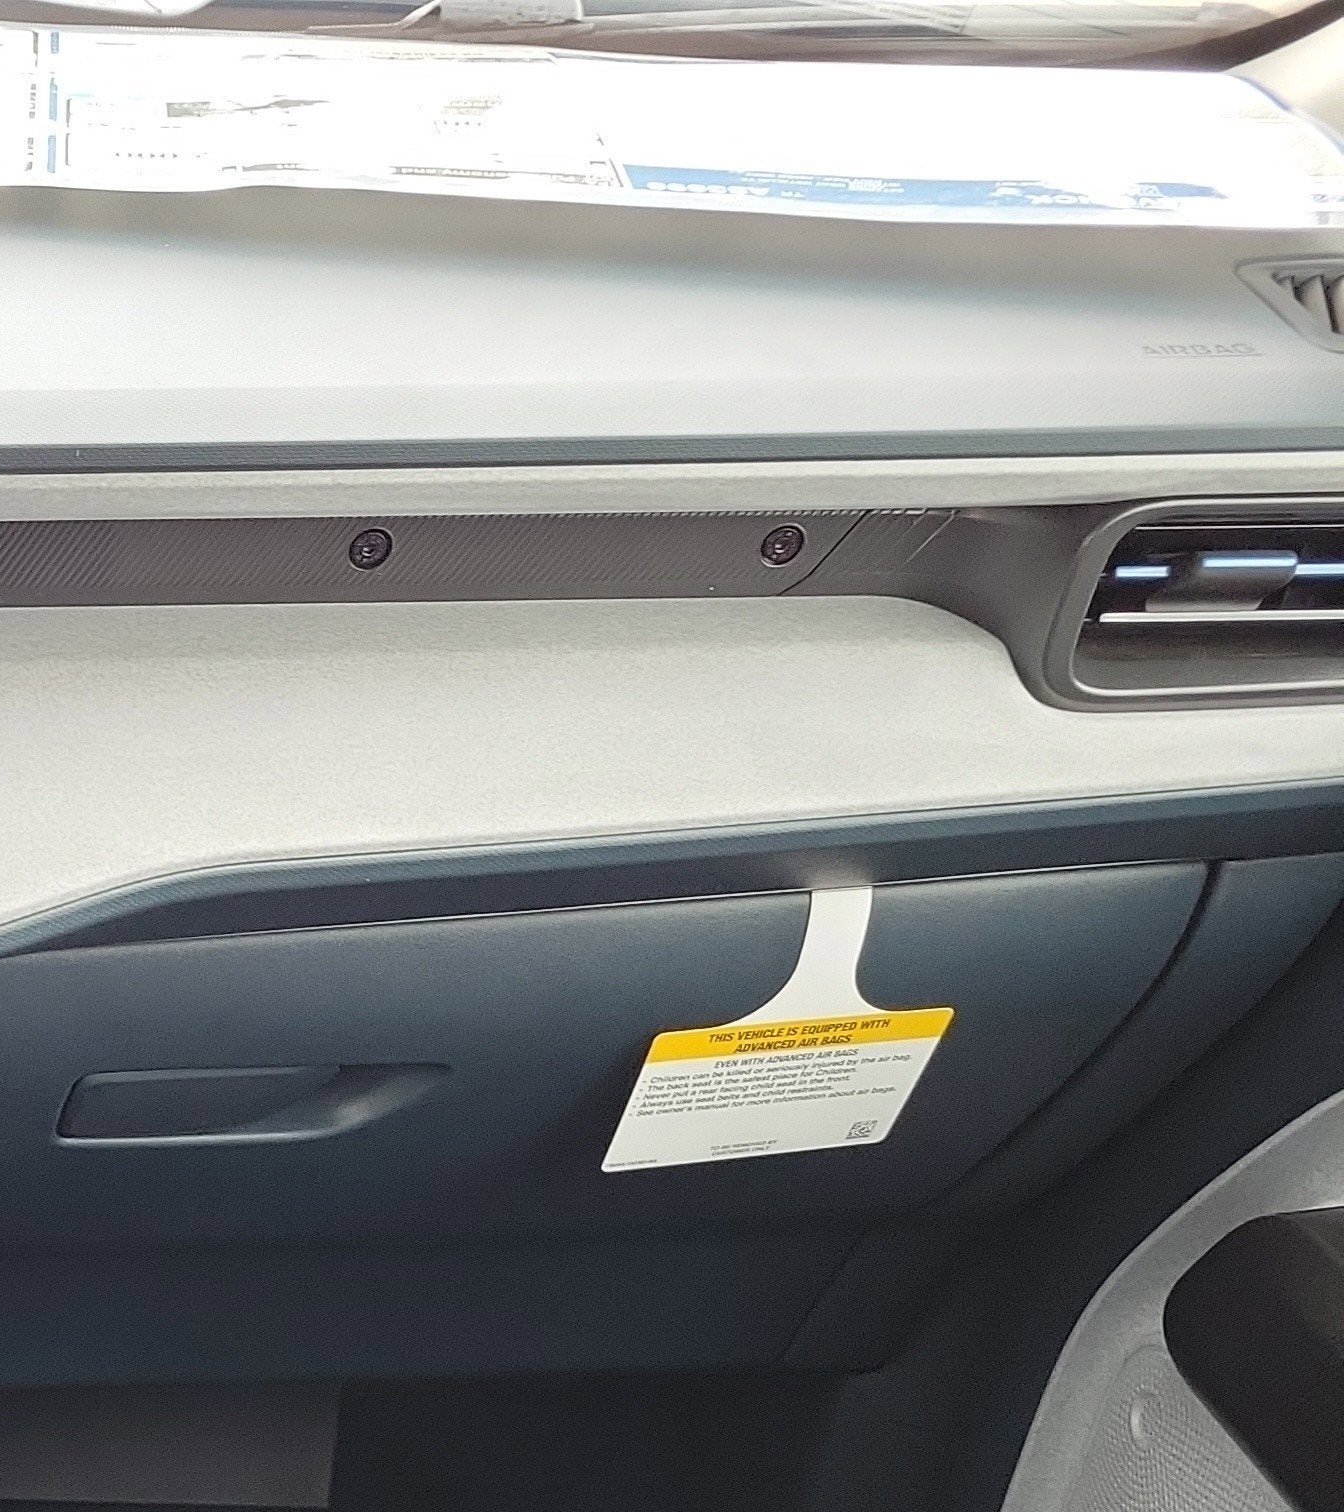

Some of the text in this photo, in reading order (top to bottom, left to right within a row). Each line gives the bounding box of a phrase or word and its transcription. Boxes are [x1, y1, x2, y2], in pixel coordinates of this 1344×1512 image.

[709, 1018, 892, 1043] THIS VEHICLE IS EQUIPPED WITH
[733, 1034, 853, 1053] ADVANCED AIR BAGS
[714, 1048, 859, 1069] EVEN WITH ADVANCED AIR BAGS
[650, 1075, 690, 1084] Children
[726, 1068, 752, 1076] killed
[766, 1063, 809, 1073] seriously
[811, 1060, 845, 1068] injured
[847, 1058, 858, 1066] by
[666, 1082, 689, 1090] back
[691, 1080, 712, 1088] seat
[743, 1075, 770, 1083] safest
[772, 1072, 798, 1080] place
[639, 1100, 673, 1109] Always
[717, 1093, 740, 1101] belts
[741, 1091, 760, 1099] and
[762, 1089, 785, 1097] child
[643, 1093, 671, 1101] Never
[673, 1090, 689, 1098] put
[719, 1085, 749, 1093] facing
[750, 1082, 775, 1091] child
[776, 1080, 797, 1088] seat
[636, 1109, 654, 1117] See
[694, 1102, 729, 1111] manual
[772, 1093, 826, 1103] information
[828, 1090, 855, 1098] about
